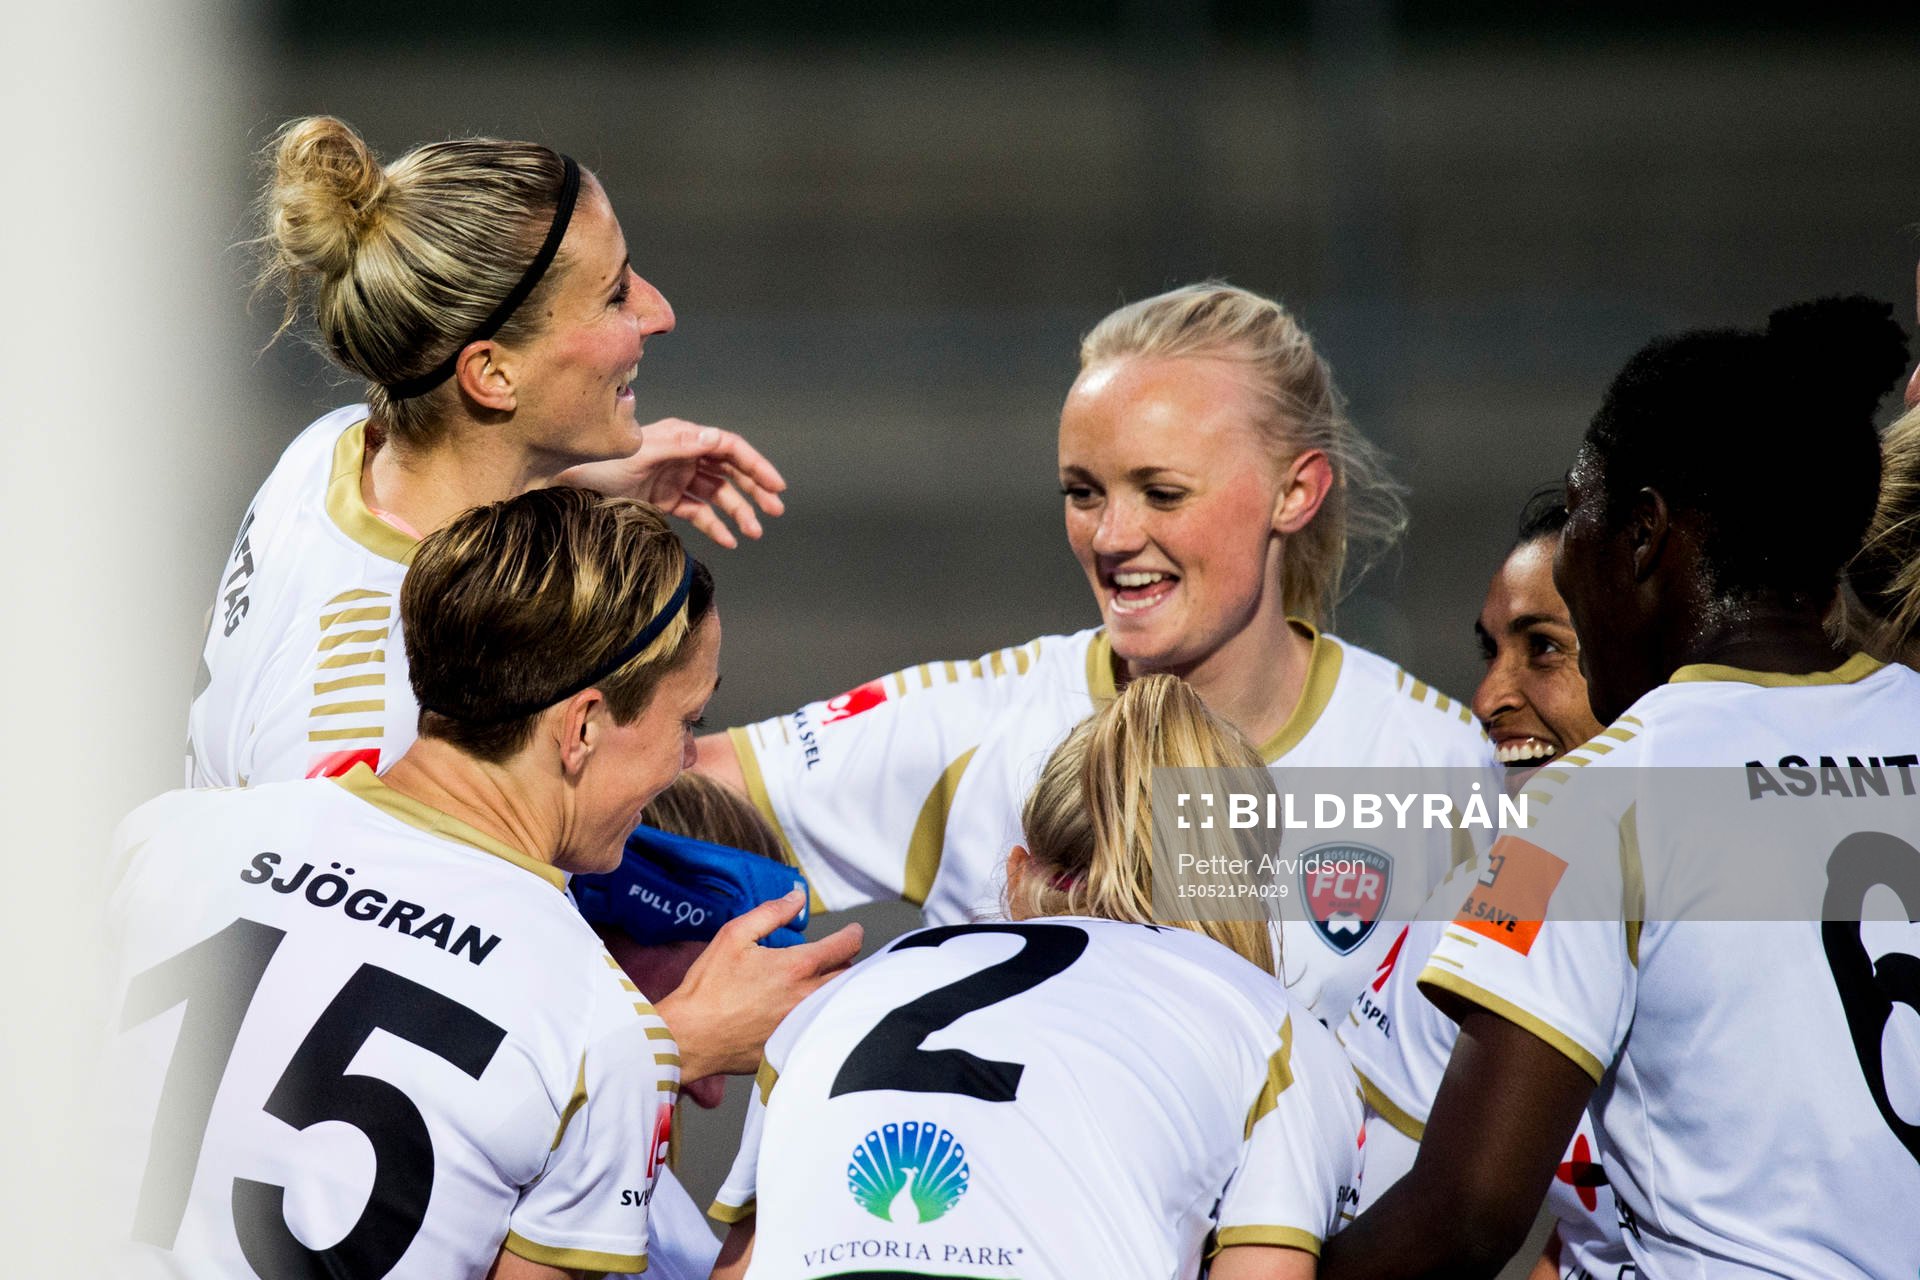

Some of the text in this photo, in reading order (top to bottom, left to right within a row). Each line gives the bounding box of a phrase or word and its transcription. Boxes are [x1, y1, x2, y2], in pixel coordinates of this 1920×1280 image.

[628, 884, 671, 915] FULL
[1312, 872, 1380, 900] FCR
[240, 852, 502, 966] SJÖGRAN
[1475, 902, 1518, 933] SAVE
[829, 923, 1090, 1102] 2
[1362, 999, 1391, 1040] SPEL
[119, 916, 508, 1280] 15
[803, 1239, 931, 1267] VICTORIA
